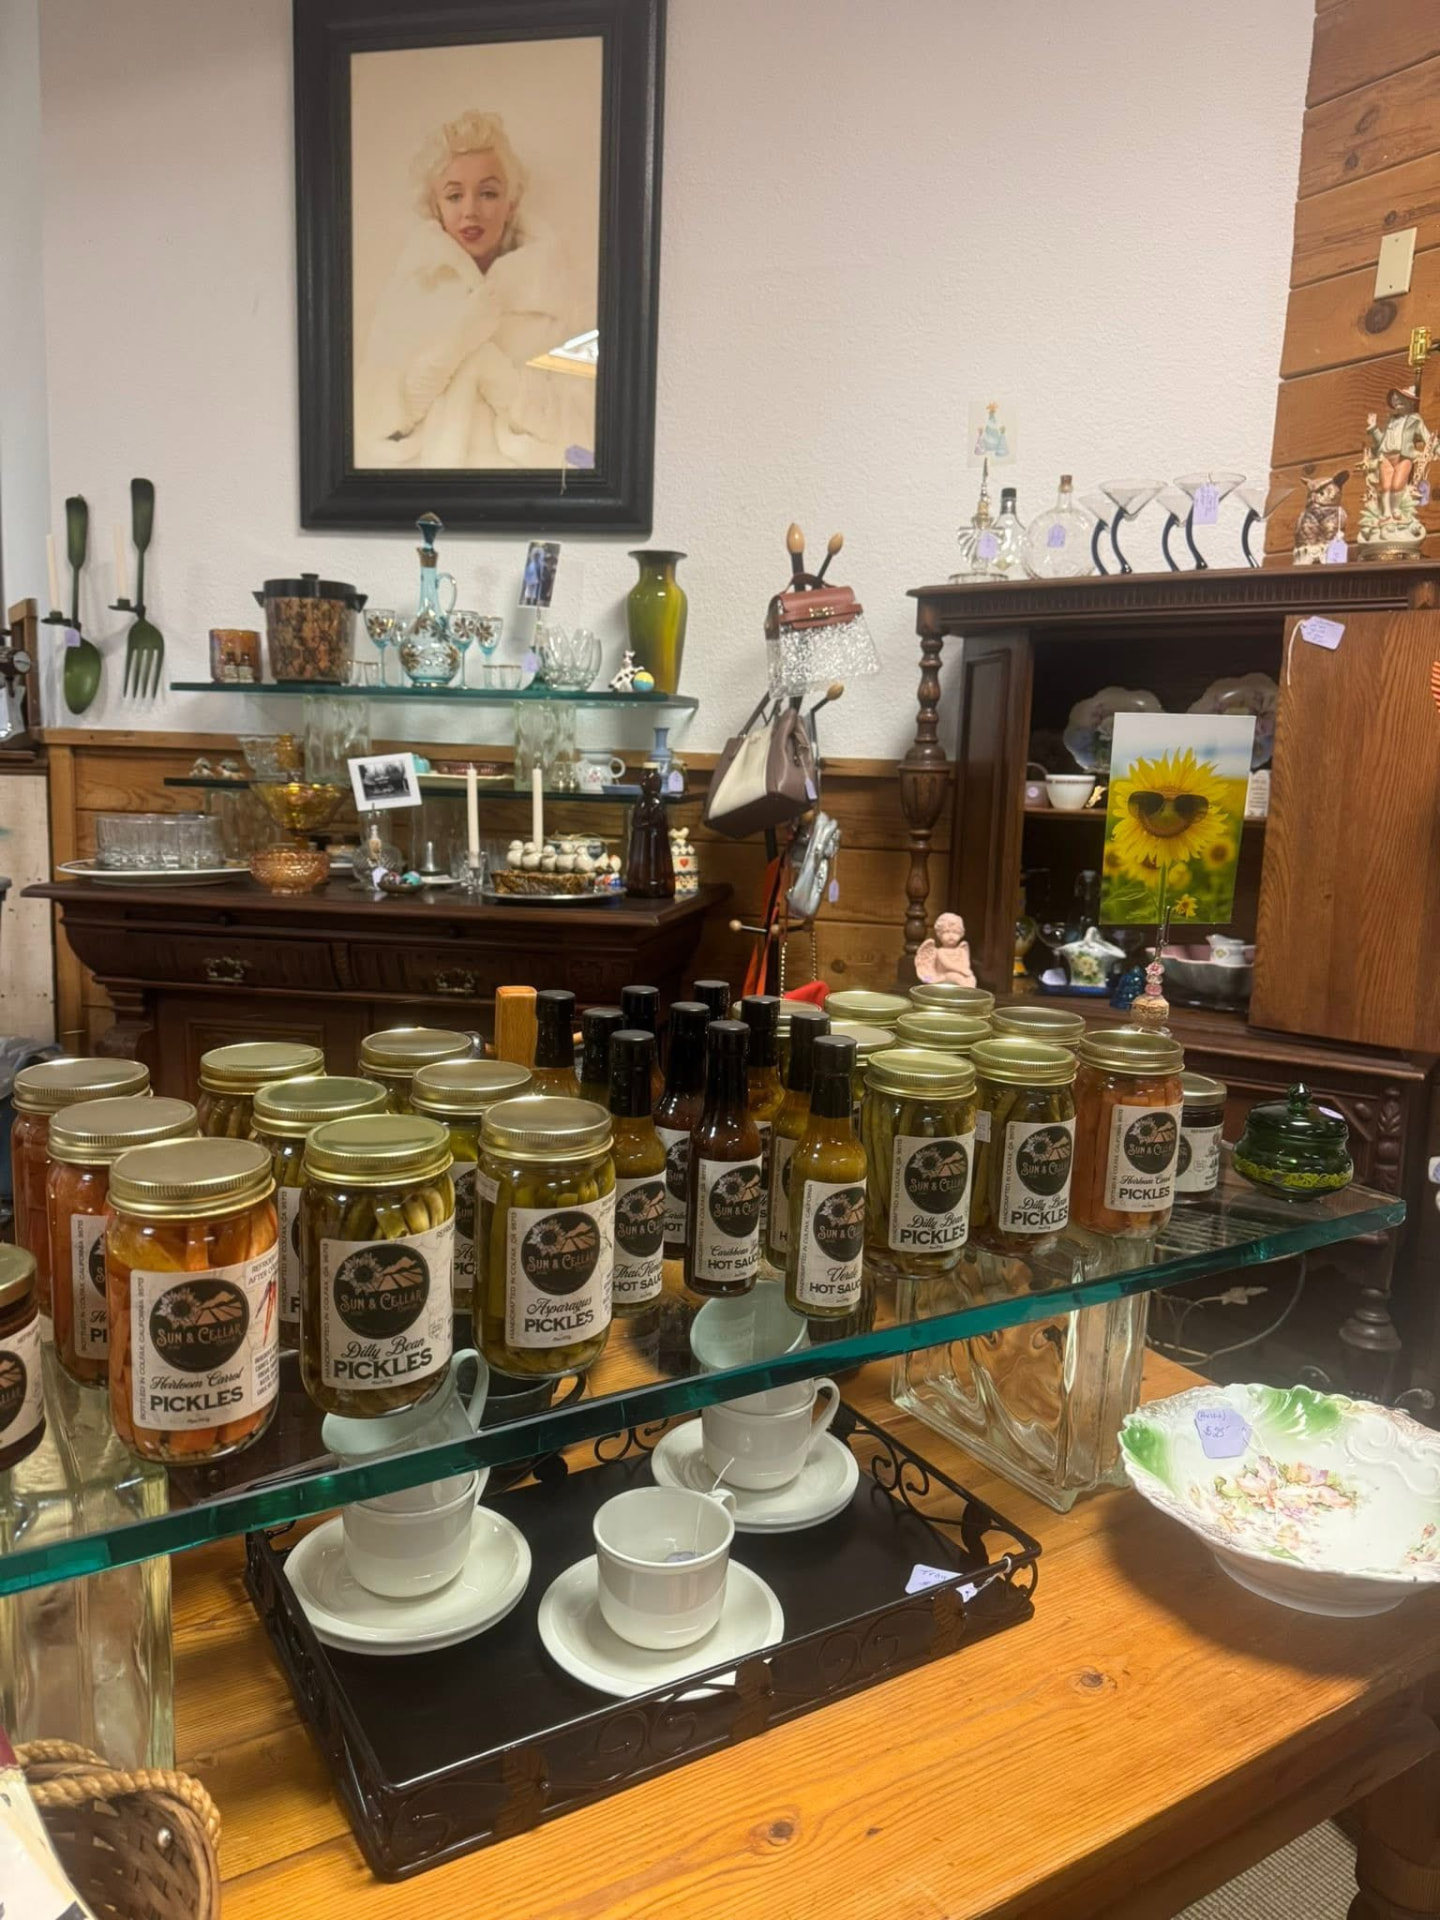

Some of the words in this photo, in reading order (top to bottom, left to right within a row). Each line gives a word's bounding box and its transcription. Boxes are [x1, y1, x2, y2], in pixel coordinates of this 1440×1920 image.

[1018, 1196, 1048, 1211] Dilly
[1119, 1186, 1170, 1200] PICKLES
[907, 1214, 938, 1231] Dilly
[1011, 1205, 1068, 1226] PICKLES
[900, 1223, 966, 1245] PICKLES
[708, 1259, 733, 1270] HOT
[734, 1254, 758, 1269] SAUC
[612, 1281, 638, 1292] HOT
[810, 1282, 836, 1294] HOT
[837, 1278, 862, 1294] SAUC
[526, 1296, 593, 1318] Asparagus
[524, 1310, 594, 1332] PICKLES
[341, 1340, 382, 1361] Dilly
[386, 1336, 425, 1357] Bean
[334, 1348, 433, 1380] PICKLES
[150, 1376, 203, 1390] Heirloom
[206, 1366, 244, 1387] Carrot
[150, 1386, 244, 1412] PICKLES
